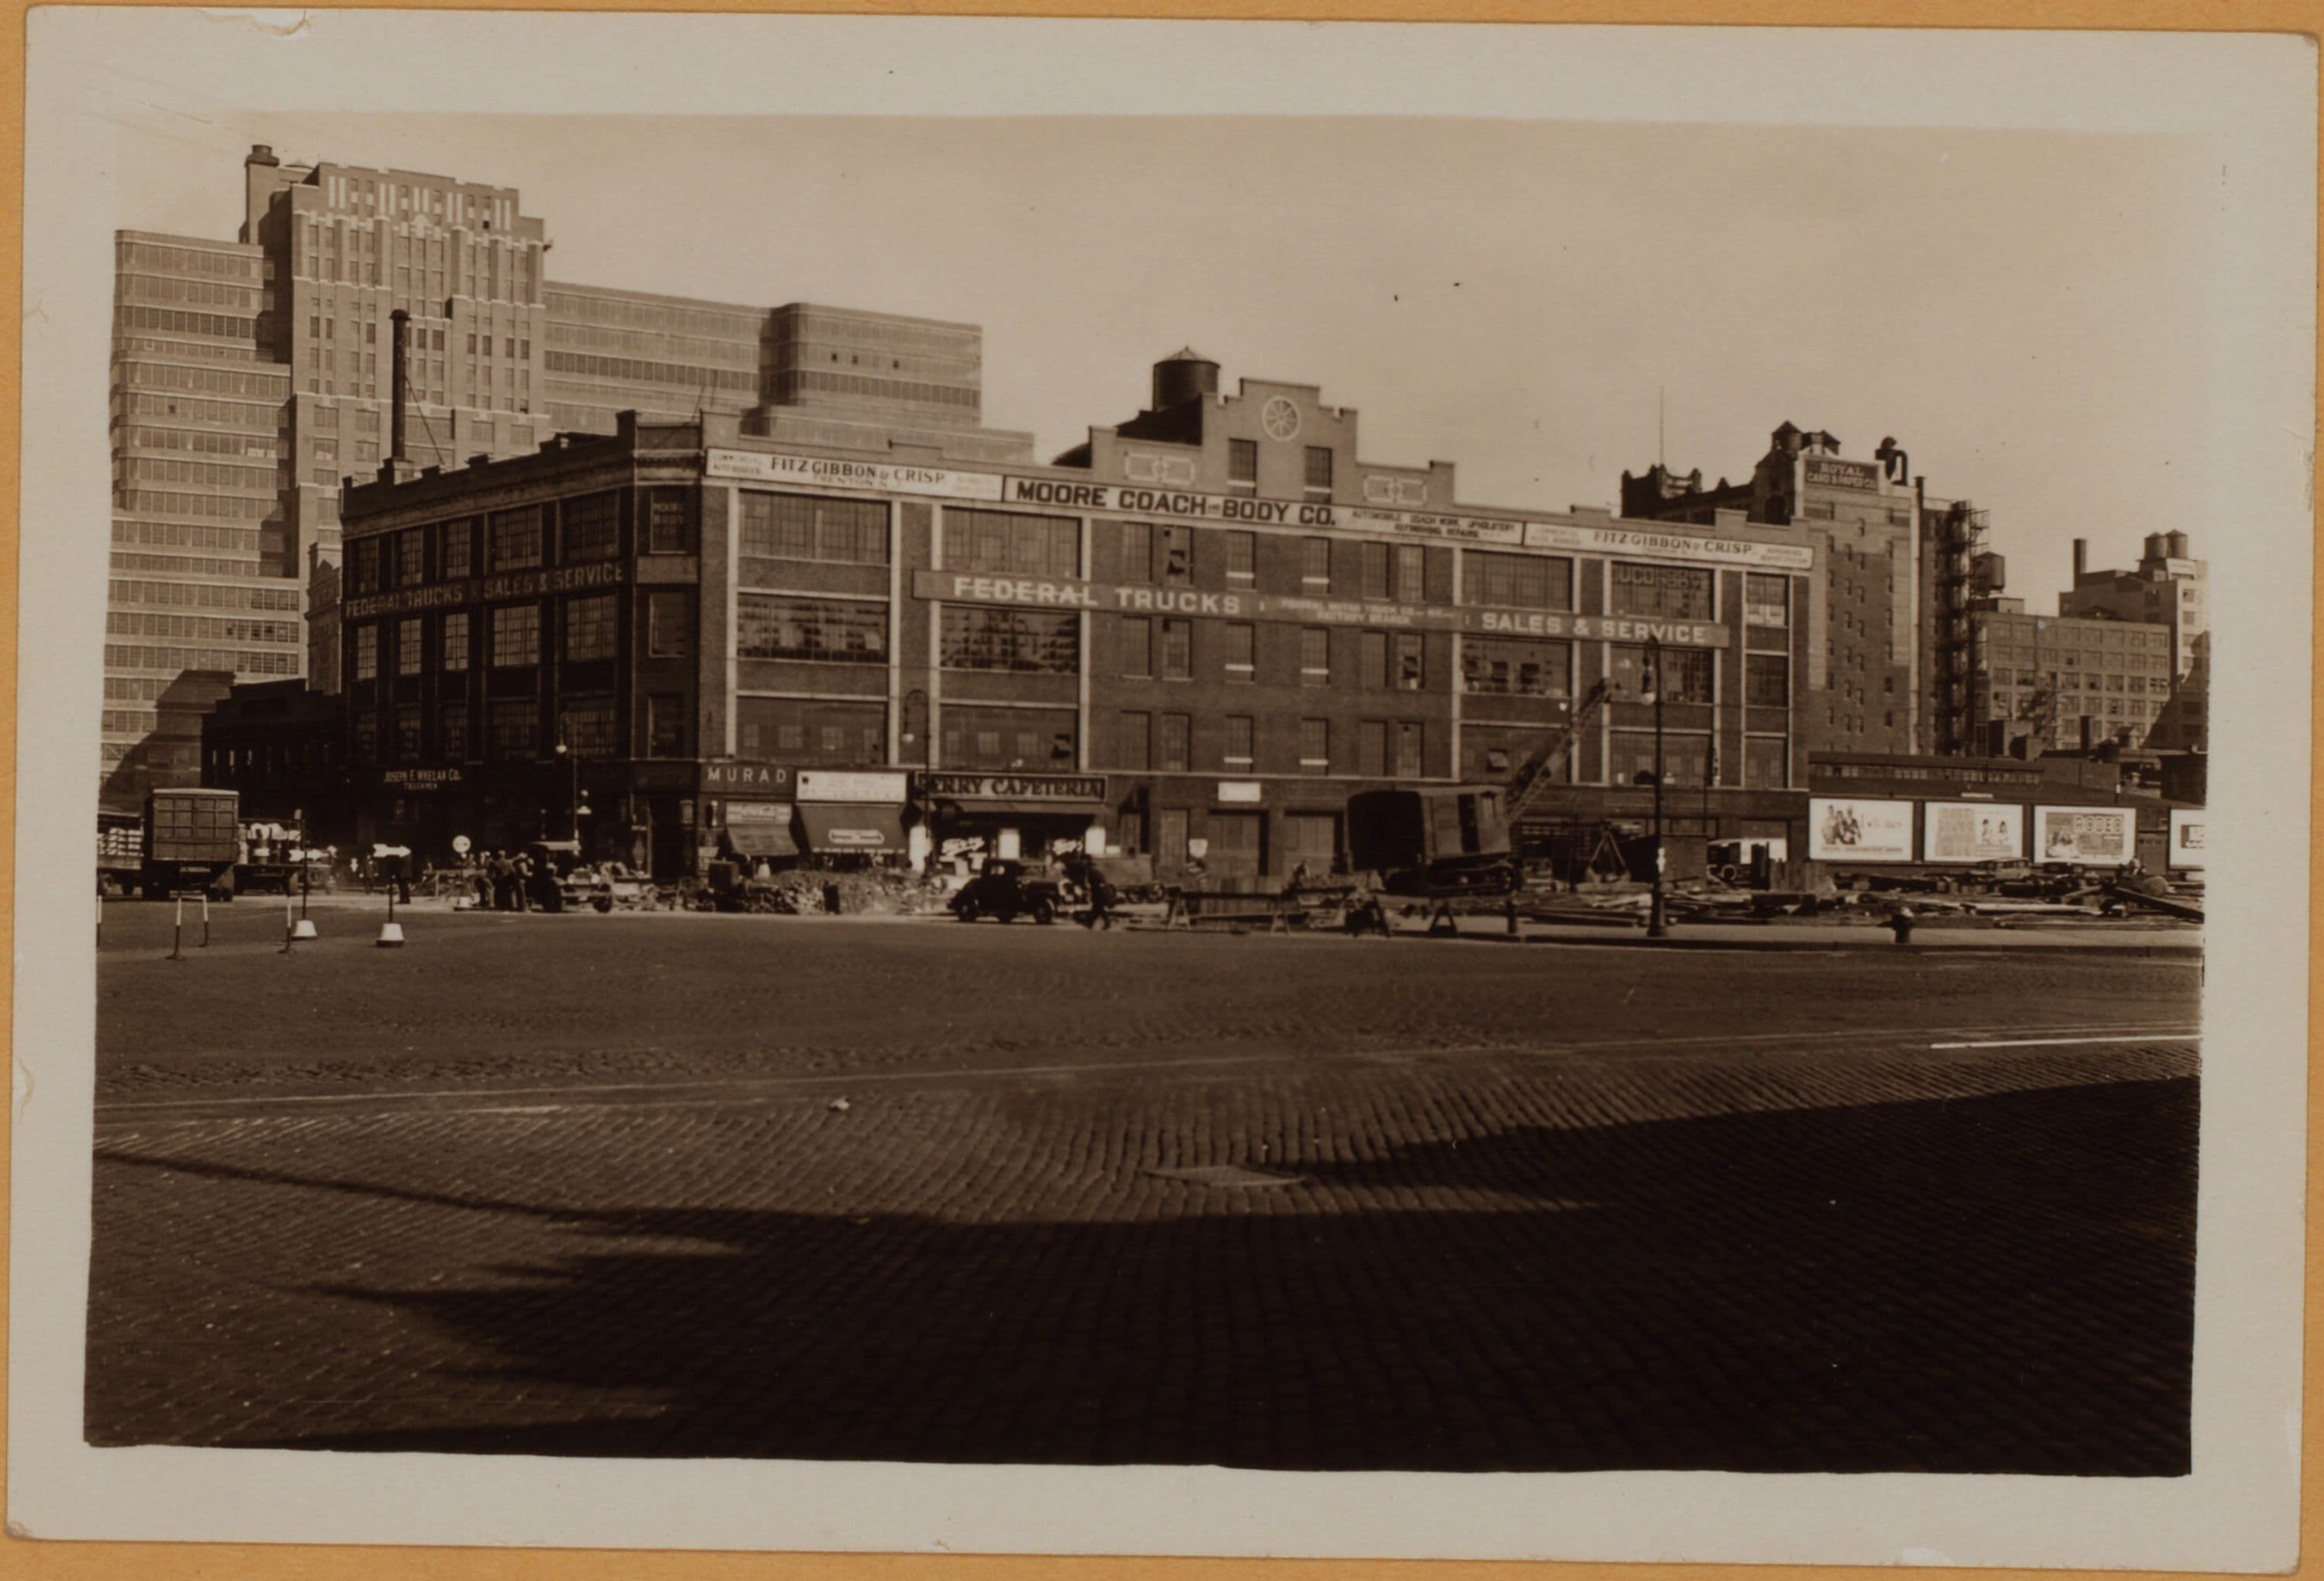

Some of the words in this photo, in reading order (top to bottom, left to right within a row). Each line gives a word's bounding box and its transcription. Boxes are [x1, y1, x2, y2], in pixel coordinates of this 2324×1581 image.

[893, 468, 946, 484] CRISP
[1820, 462, 1865, 477] ROYAL
[1016, 480, 1108, 506] MOORE
[1299, 506, 1336, 526] CO.
[1704, 540, 1752, 554] CRISP
[346, 594, 402, 618] FEDERAL
[406, 584, 463, 609] TRUCKS
[484, 574, 534, 599] SALES
[539, 571, 548, 592] &
[554, 561, 623, 590] SERVICE
[954, 578, 1098, 606] FEDERAL
[1115, 587, 1239, 613] TRUCKS
[1482, 612, 1562, 634] SALES
[1573, 618, 1591, 636] &
[1602, 620, 1705, 643] SERVICE
[708, 766, 787, 783] MURAD
[992, 777, 1102, 798] CAFETERIA
[2074, 815, 2123, 834] RODEO
